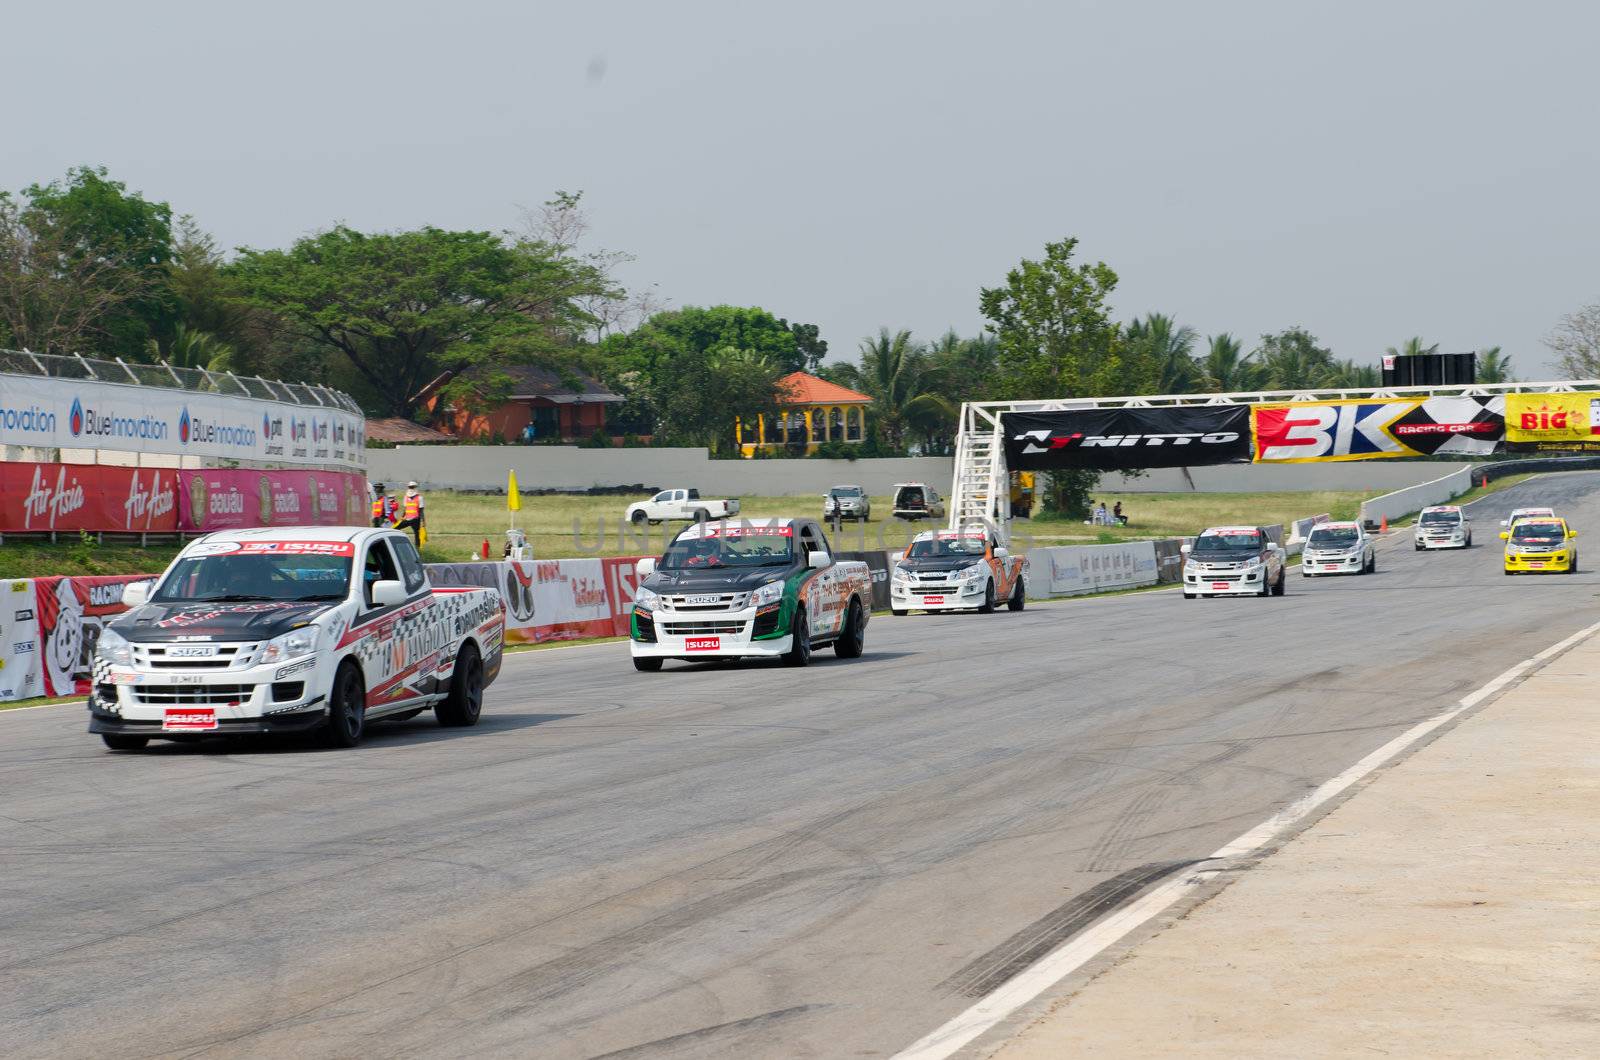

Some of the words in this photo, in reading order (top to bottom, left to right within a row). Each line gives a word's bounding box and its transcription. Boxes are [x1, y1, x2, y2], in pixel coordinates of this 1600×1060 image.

[86, 410, 168, 441] BlueInnovation
[1520, 412, 1568, 430] BIG
[192, 418, 256, 447] BlueInnovation
[1080, 431, 1241, 447] NITTO
[283, 543, 349, 552] ISUZU
[684, 596, 718, 605] ISUZU
[686, 641, 719, 649] ISUZU
[166, 714, 216, 724] ISUZU
